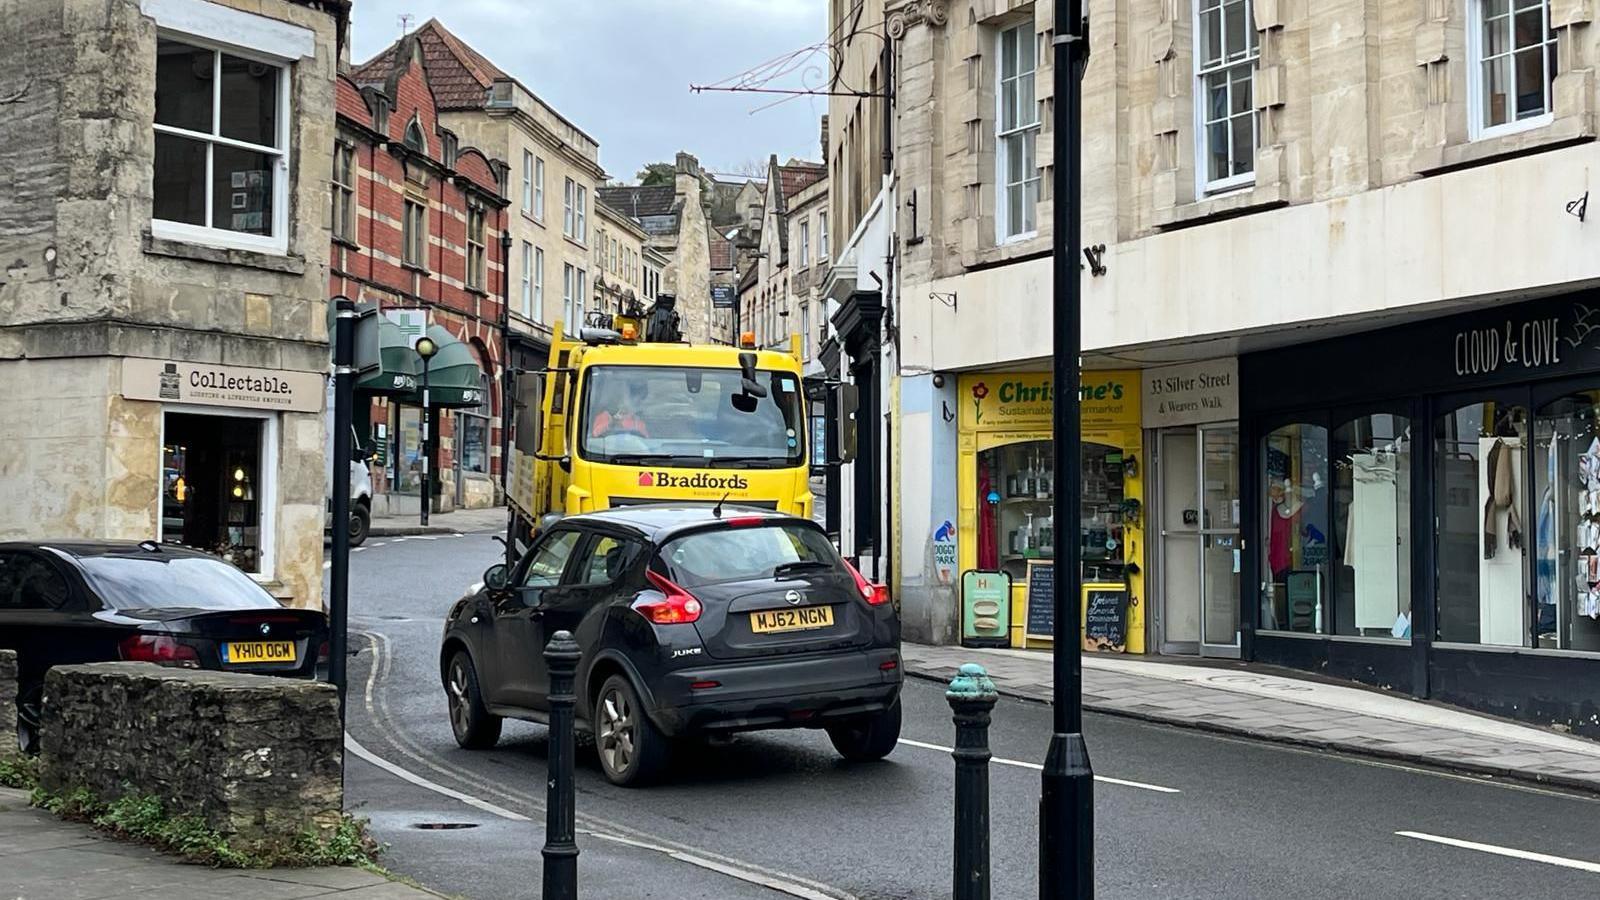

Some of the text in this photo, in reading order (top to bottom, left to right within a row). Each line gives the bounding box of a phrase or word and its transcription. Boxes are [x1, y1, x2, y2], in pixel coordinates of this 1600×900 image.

[1455, 318, 1560, 376] CLOUD & COVE
[190, 371, 292, 394] Collectable.
[1151, 372, 1230, 395] 33 Silver Street
[998, 381, 1124, 403] Chrine's
[1158, 397, 1222, 413] & Weavers Walk
[656, 472, 748, 489] Bradfords
[935, 545, 956, 555] DOGGY
[936, 555, 956, 565] PARK
[757, 609, 828, 629] MJ62 NGN
[233, 643, 290, 659] YH10 OGM
[671, 647, 702, 659] JUKE
